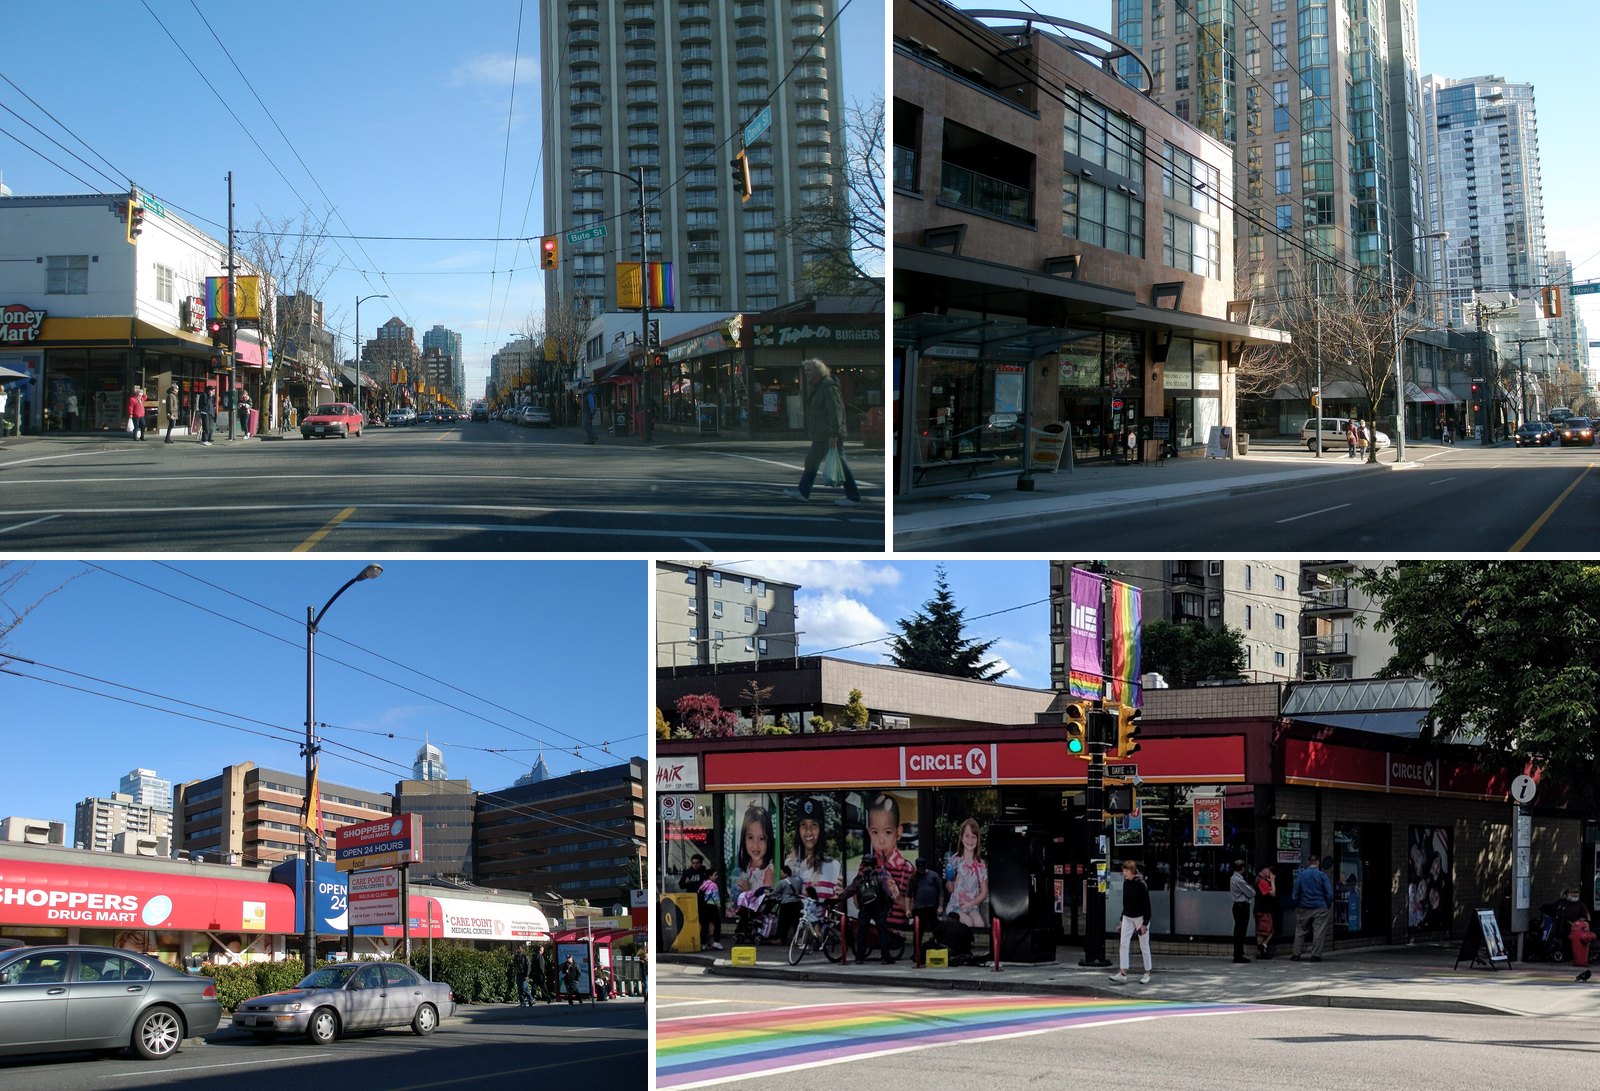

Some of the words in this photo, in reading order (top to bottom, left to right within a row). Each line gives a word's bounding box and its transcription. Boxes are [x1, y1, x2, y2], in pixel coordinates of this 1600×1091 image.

[571, 230, 591, 242] Bute
[593, 228, 603, 237] St
[1572, 286, 1594, 295] Howe
[835, 329, 880, 340] BURGERS
[910, 755, 962, 771] CIRCLE
[1111, 766, 1125, 775] DAVIE
[1392, 762, 1422, 780] CIRCLE
[343, 823, 390, 839] SHOPPERS
[361, 833, 375, 841] DRUG
[375, 830, 390, 838] MART
[343, 848, 363, 858] OPEN
[364, 846, 373, 855] 24
[374, 841, 404, 852] HOURS
[352, 877, 367, 887] CARE
[368, 875, 385, 885] POINT
[319, 883, 348, 896] OPEN
[0, 887, 138, 911] HOPPERS
[330, 896, 348, 910] 24
[48, 909, 92, 921] DRUG
[96, 912, 137, 922] MART
[450, 916, 471, 927] CARE
[472, 918, 492, 928] POINT
